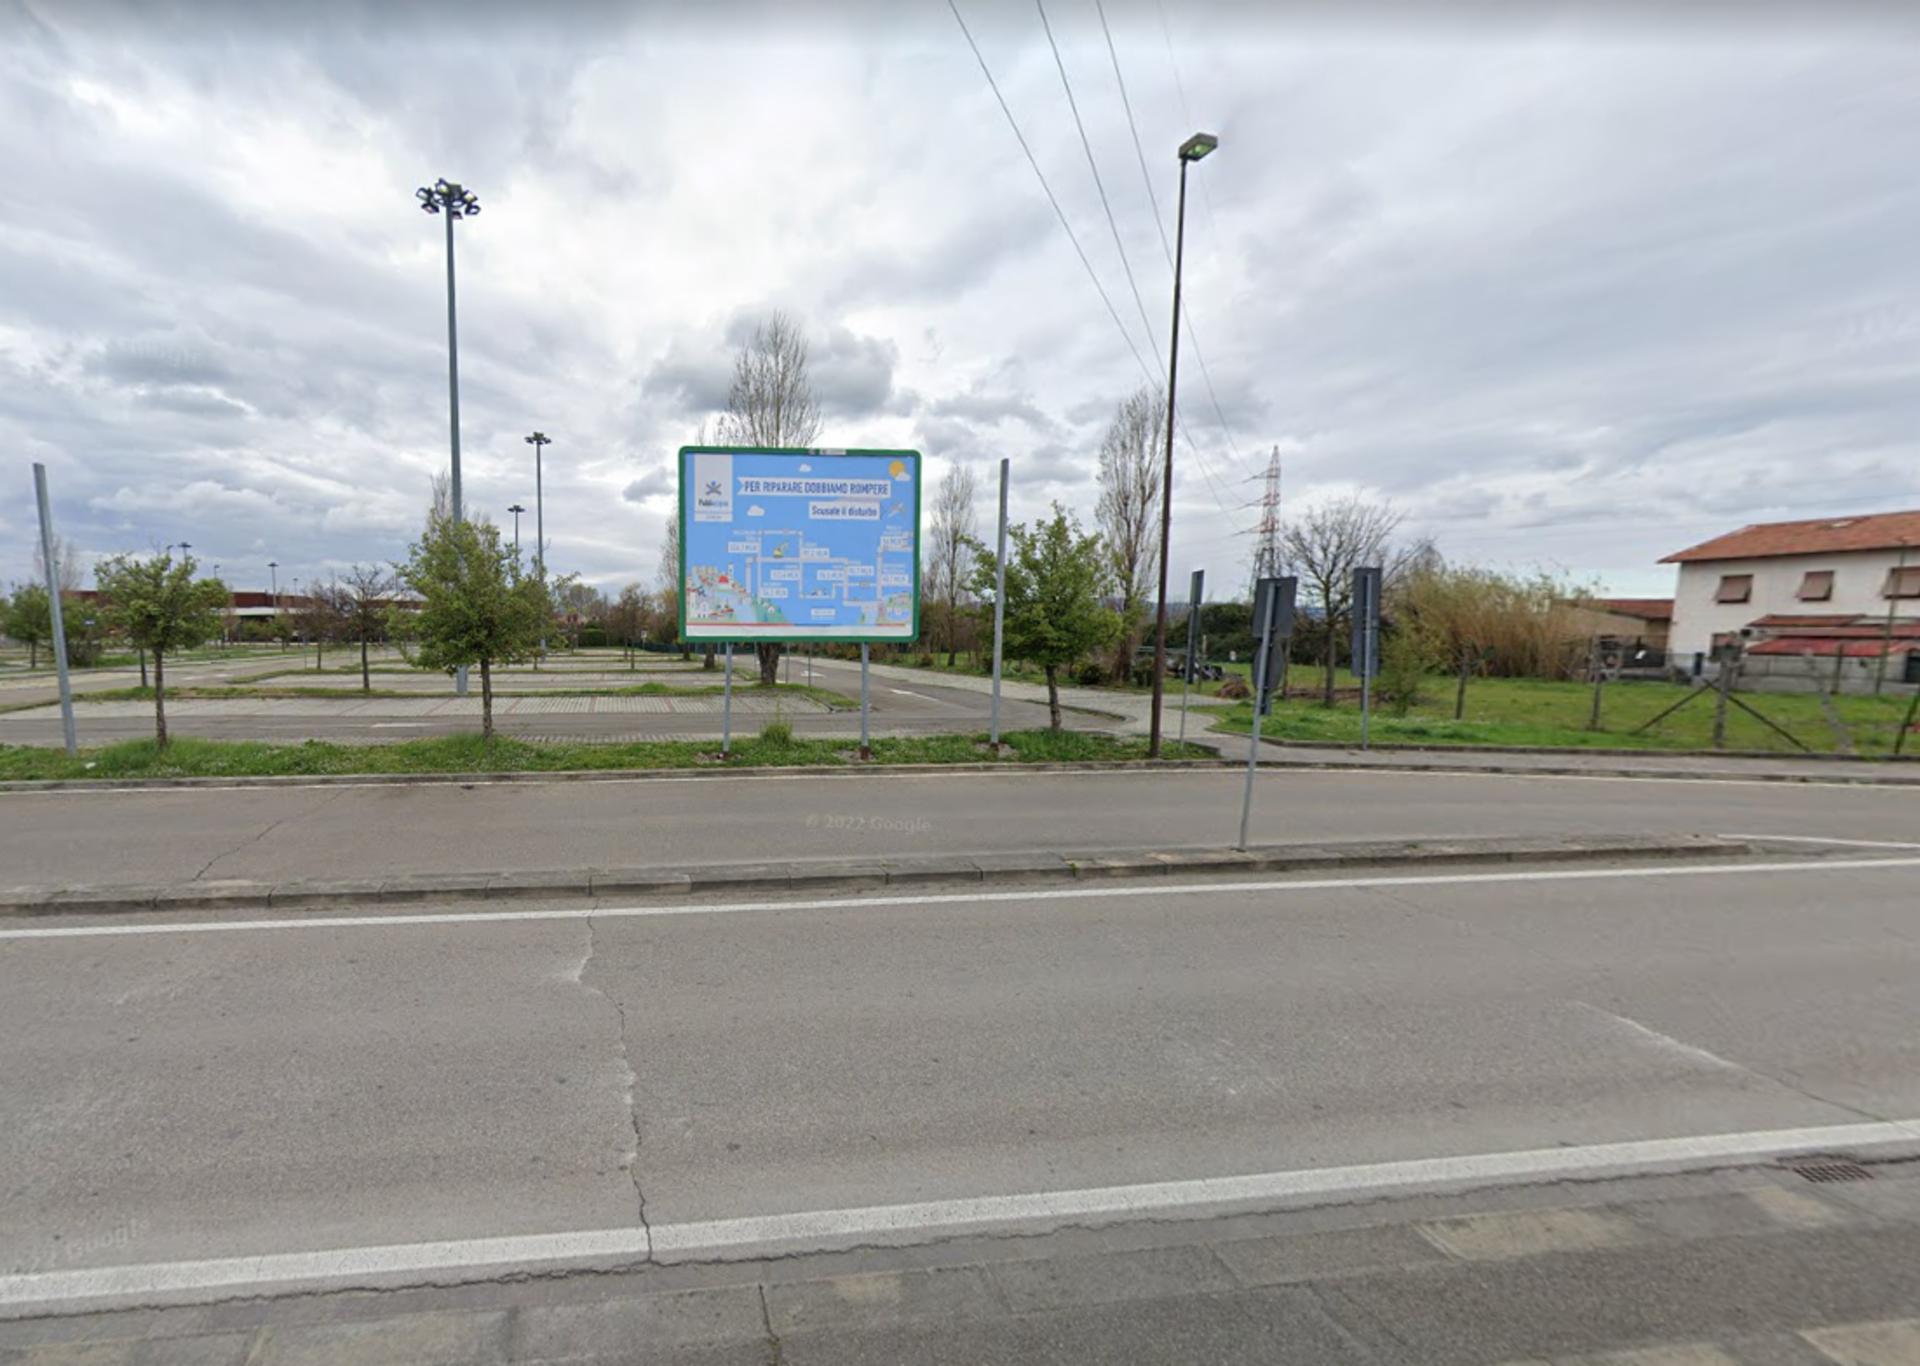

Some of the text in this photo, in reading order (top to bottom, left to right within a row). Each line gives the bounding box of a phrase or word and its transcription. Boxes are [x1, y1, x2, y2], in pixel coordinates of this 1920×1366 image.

[744, 480, 889, 496] PER RIPARARE DOBBIAMO ROMPERE
[811, 505, 840, 516] Scusate
[848, 506, 877, 517] disturbo
